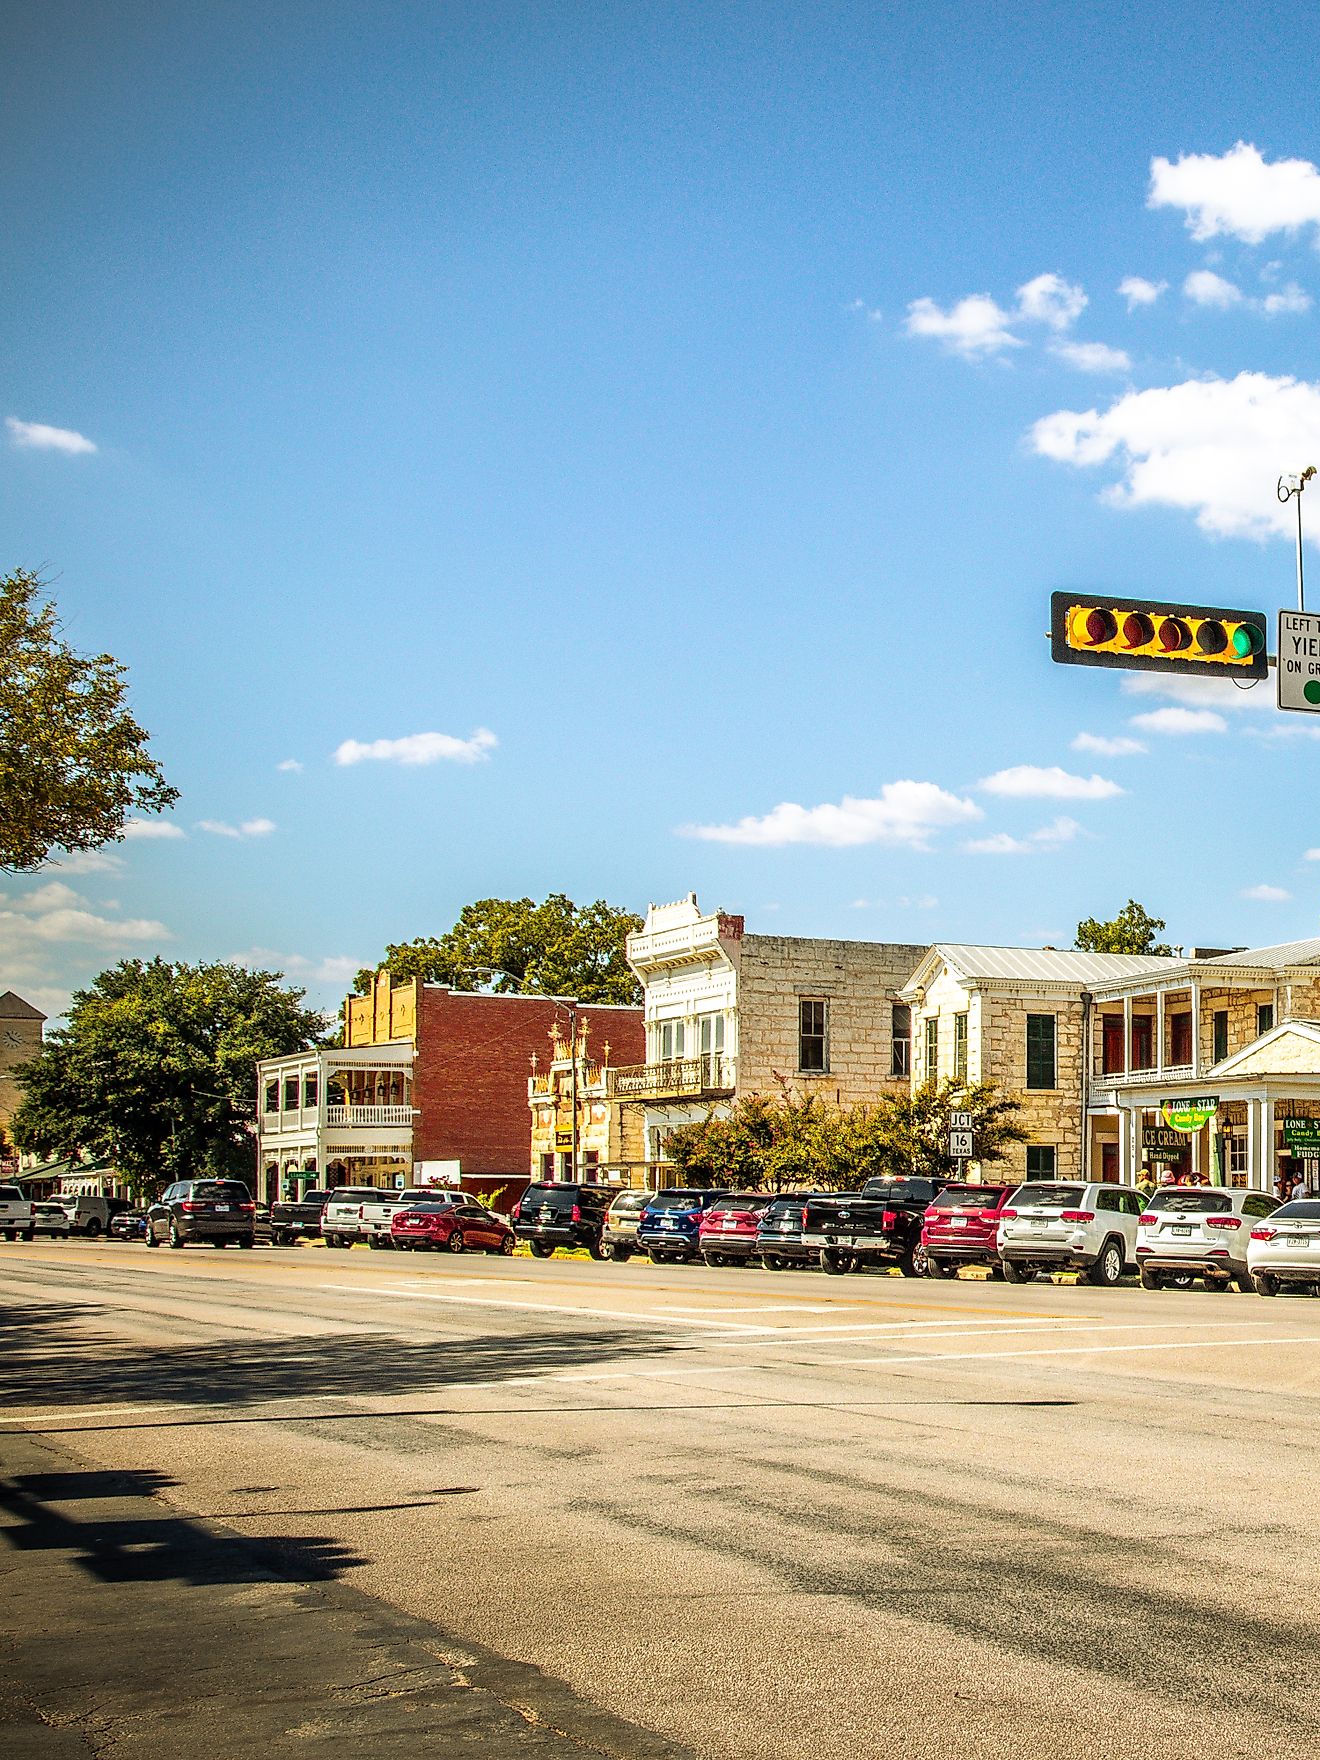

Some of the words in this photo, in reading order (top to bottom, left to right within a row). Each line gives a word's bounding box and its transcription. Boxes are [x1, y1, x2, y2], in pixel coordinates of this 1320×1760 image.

[1286, 617, 1311, 632] LEFT
[1172, 1100, 1191, 1113] LONE
[1197, 1099, 1216, 1112] STAR
[952, 1114, 971, 1126] JCT
[1285, 1120, 1306, 1129] LONE
[1142, 1130, 1156, 1145] ICE
[1158, 1130, 1186, 1146] CREAM
[1291, 1130, 1313, 1138] Candy
[956, 1135, 967, 1146] 16
[1162, 1152, 1180, 1161] Dipped
